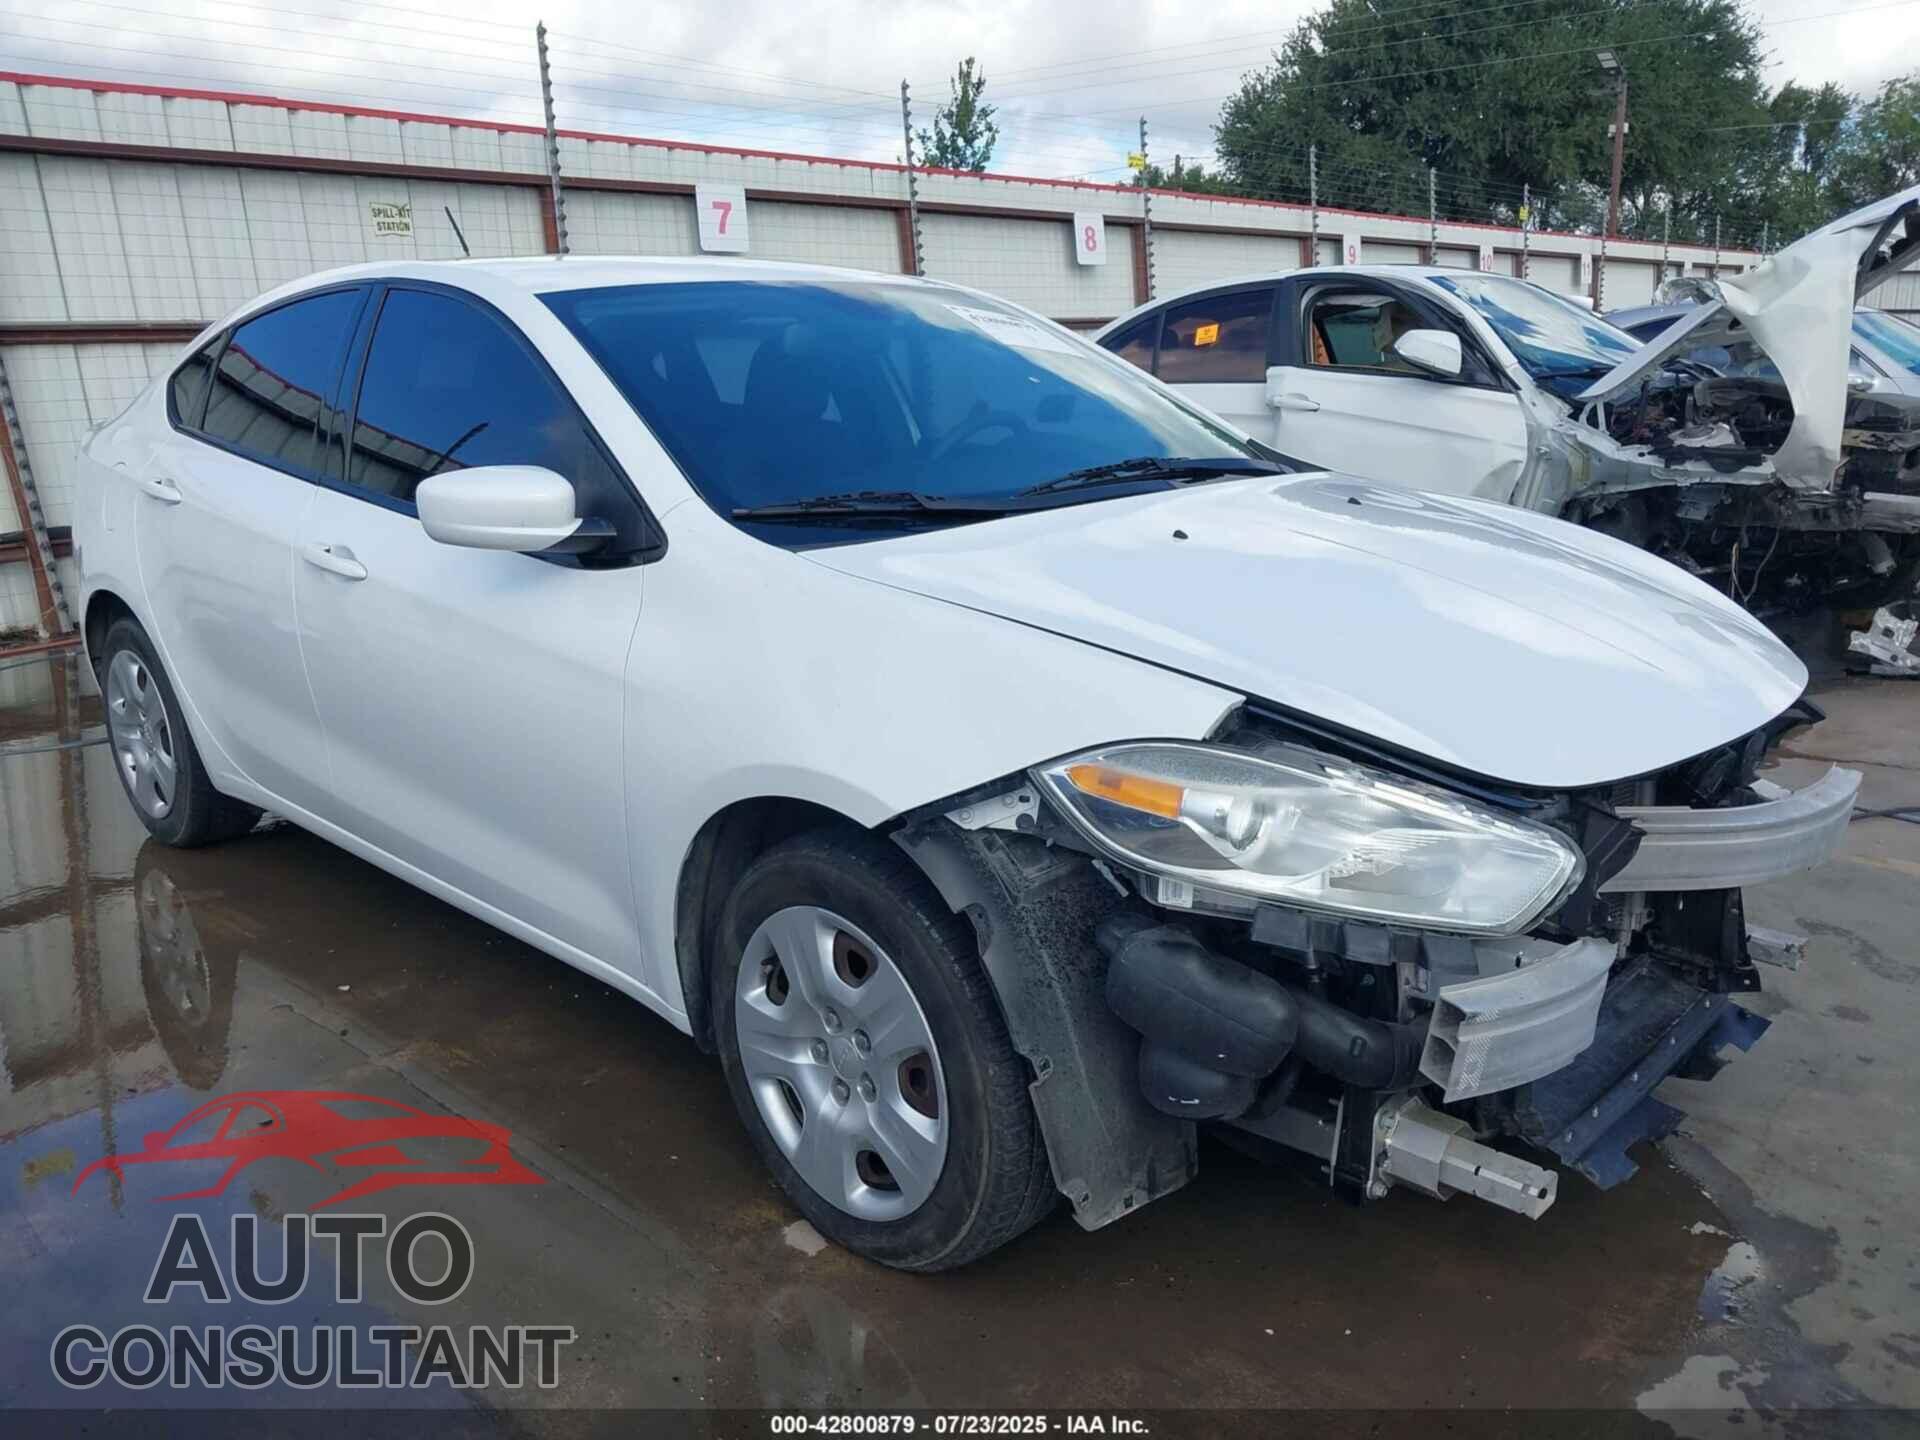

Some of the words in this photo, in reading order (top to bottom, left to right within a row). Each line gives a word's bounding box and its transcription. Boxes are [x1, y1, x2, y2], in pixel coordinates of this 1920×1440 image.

[377, 221, 410, 231] STATION
[712, 201, 732, 234] 7
[1085, 226, 1097, 251] 8
[1348, 245, 1356, 264] 9
[1481, 254, 1493, 271] 10
